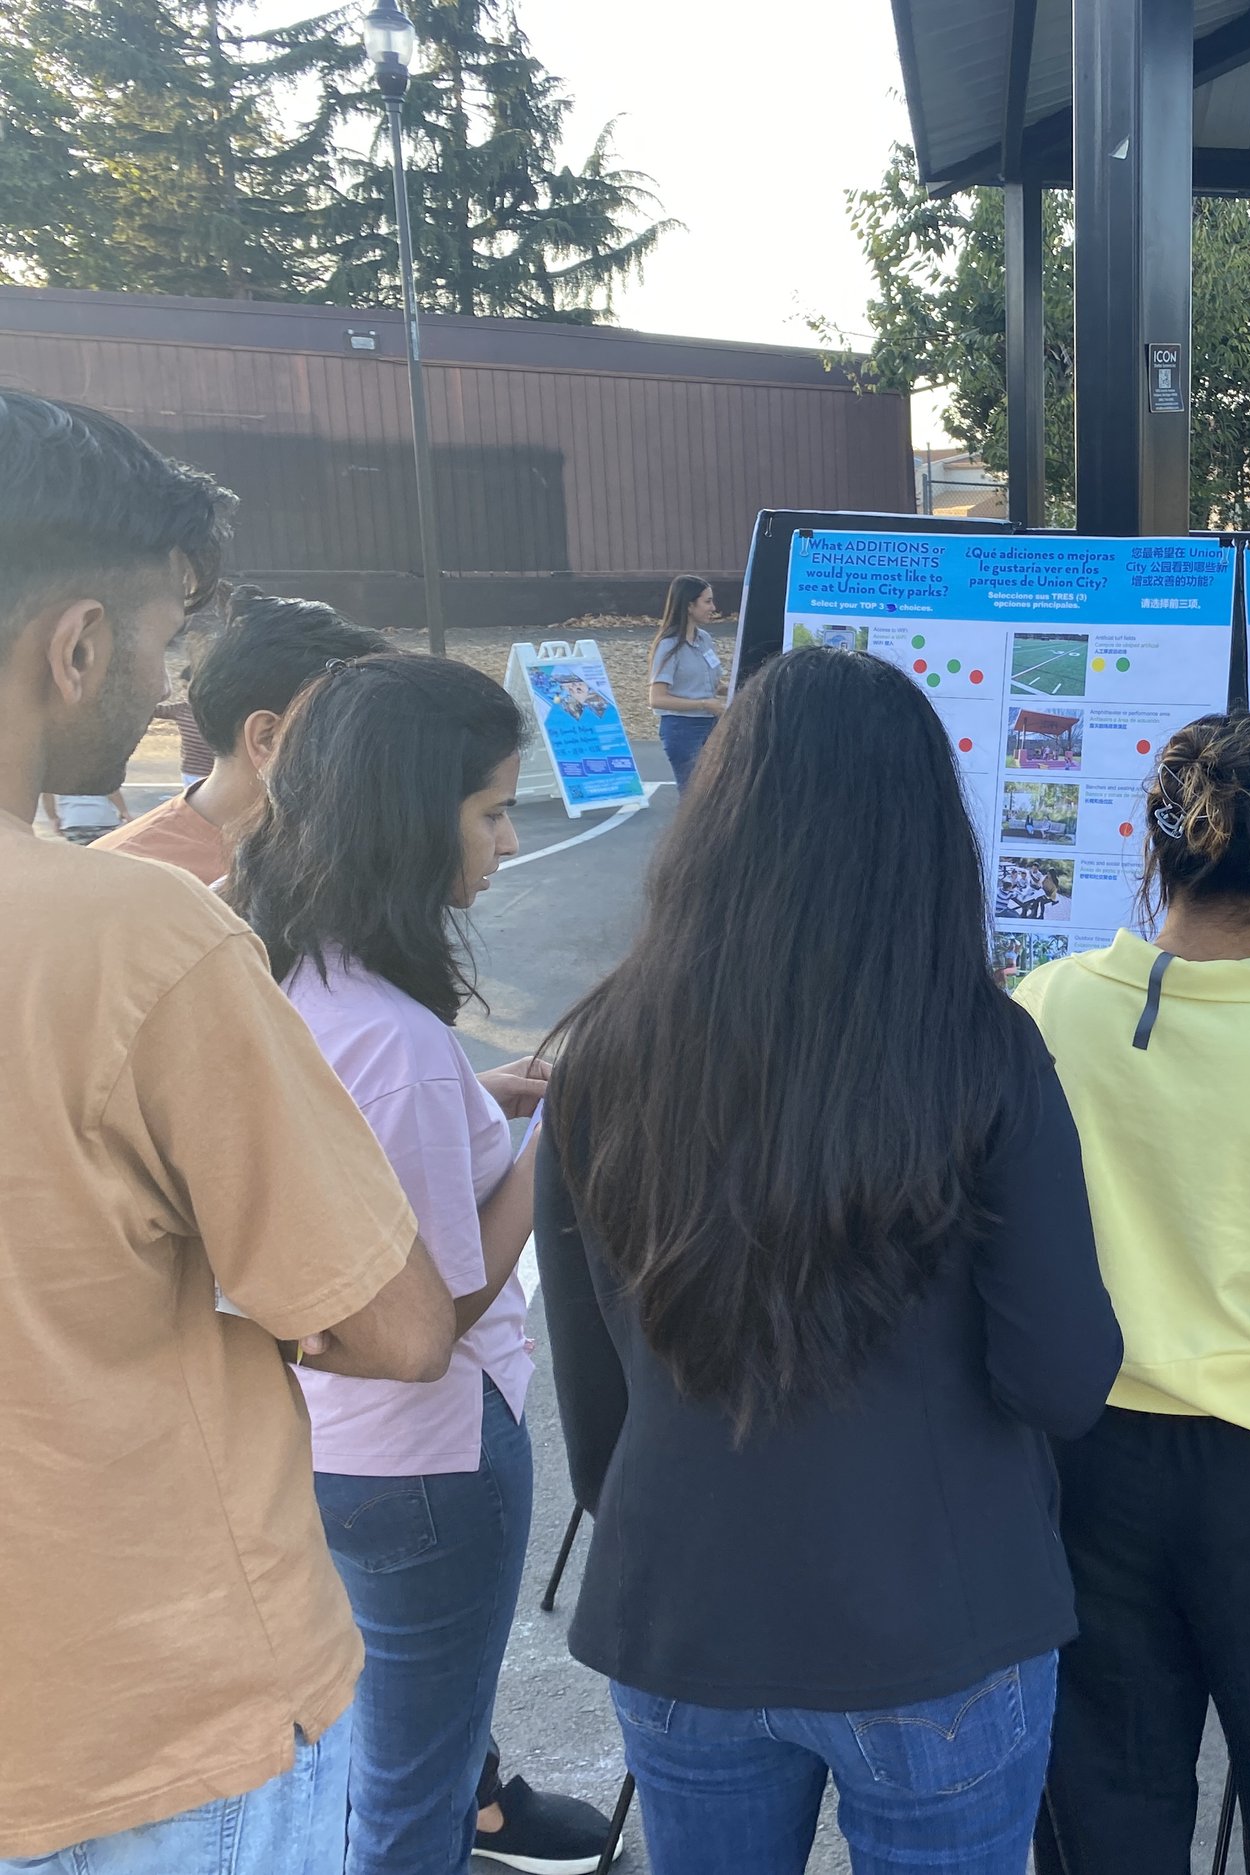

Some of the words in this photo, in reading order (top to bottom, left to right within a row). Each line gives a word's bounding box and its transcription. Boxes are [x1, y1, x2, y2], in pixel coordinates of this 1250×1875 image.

[1153, 350, 1177, 363] ICON
[809, 538, 842, 551] What
[844, 540, 929, 554] ADDITIONS
[932, 547, 945, 555] or
[1189, 548, 1223, 558] Union
[812, 553, 939, 568] ENHANCEMENTS
[965, 547, 996, 560] ¿Qué
[1000, 547, 1054, 560] adiciones
[1067, 550, 1115, 564] mejoras
[806, 566, 842, 579] would
[846, 571, 867, 583] you
[871, 572, 902, 582] most
[905, 569, 926, 582] like
[930, 573, 942, 583] to
[980, 560, 990, 572] le
[1044, 566, 1062, 574] ver
[1065, 566, 1079, 574] en
[1082, 562, 1099, 575] los
[1125, 562, 1146, 574] City
[798, 584, 818, 592] see
[821, 583, 834, 593] at
[837, 582, 875, 595] Union
[878, 584, 904, 599] City
[907, 585, 949, 599] parks?
[969, 577, 1017, 588] parques
[1020, 575, 1034, 587] de
[1037, 576, 1072, 588] Union
[1075, 576, 1108, 591] City?
[811, 599, 837, 608] Select
[840, 602, 857, 610] your
[860, 601, 877, 609] TOP
[899, 603, 933, 612] choices.
